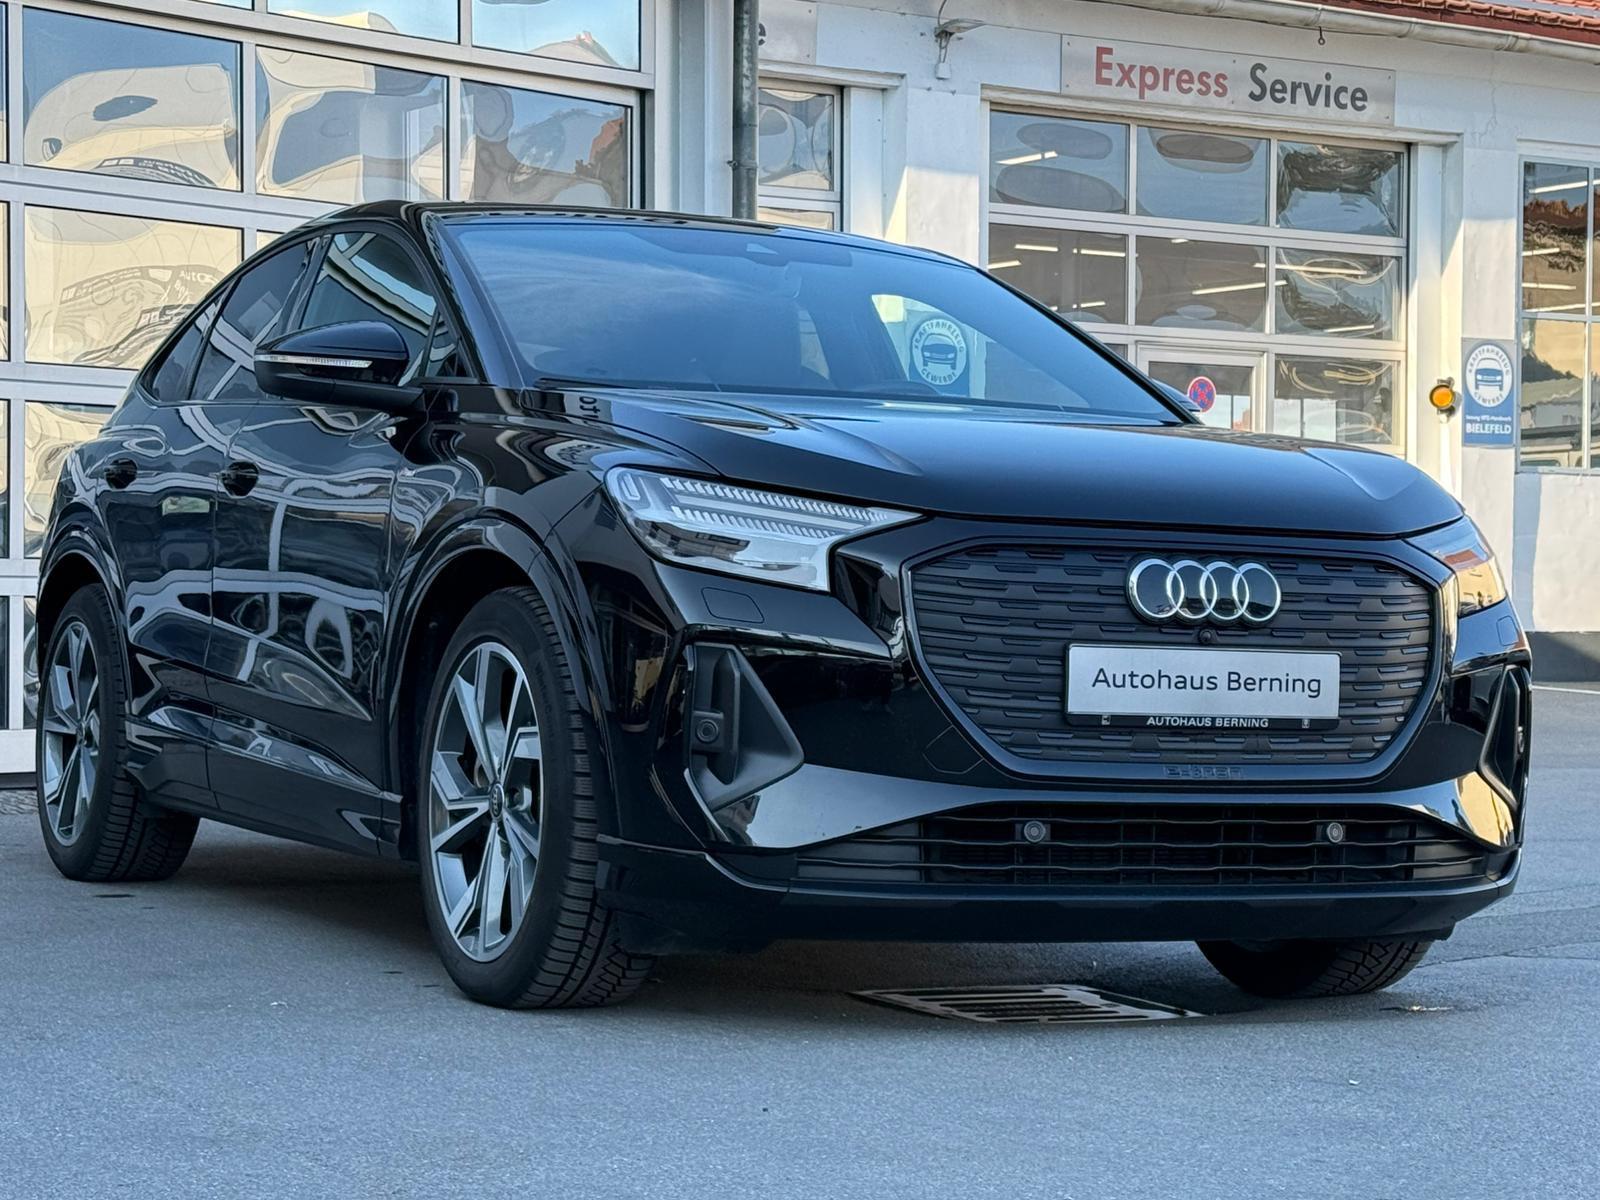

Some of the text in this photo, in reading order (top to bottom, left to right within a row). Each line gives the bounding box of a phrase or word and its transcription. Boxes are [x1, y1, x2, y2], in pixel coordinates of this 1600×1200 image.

[1094, 46, 1369, 112] Express Service
[1466, 423, 1511, 434] BIELEFELD
[1091, 667, 1321, 698] Autohaus Berning
[1146, 716, 1269, 729] AUTOHAUS BERNING
